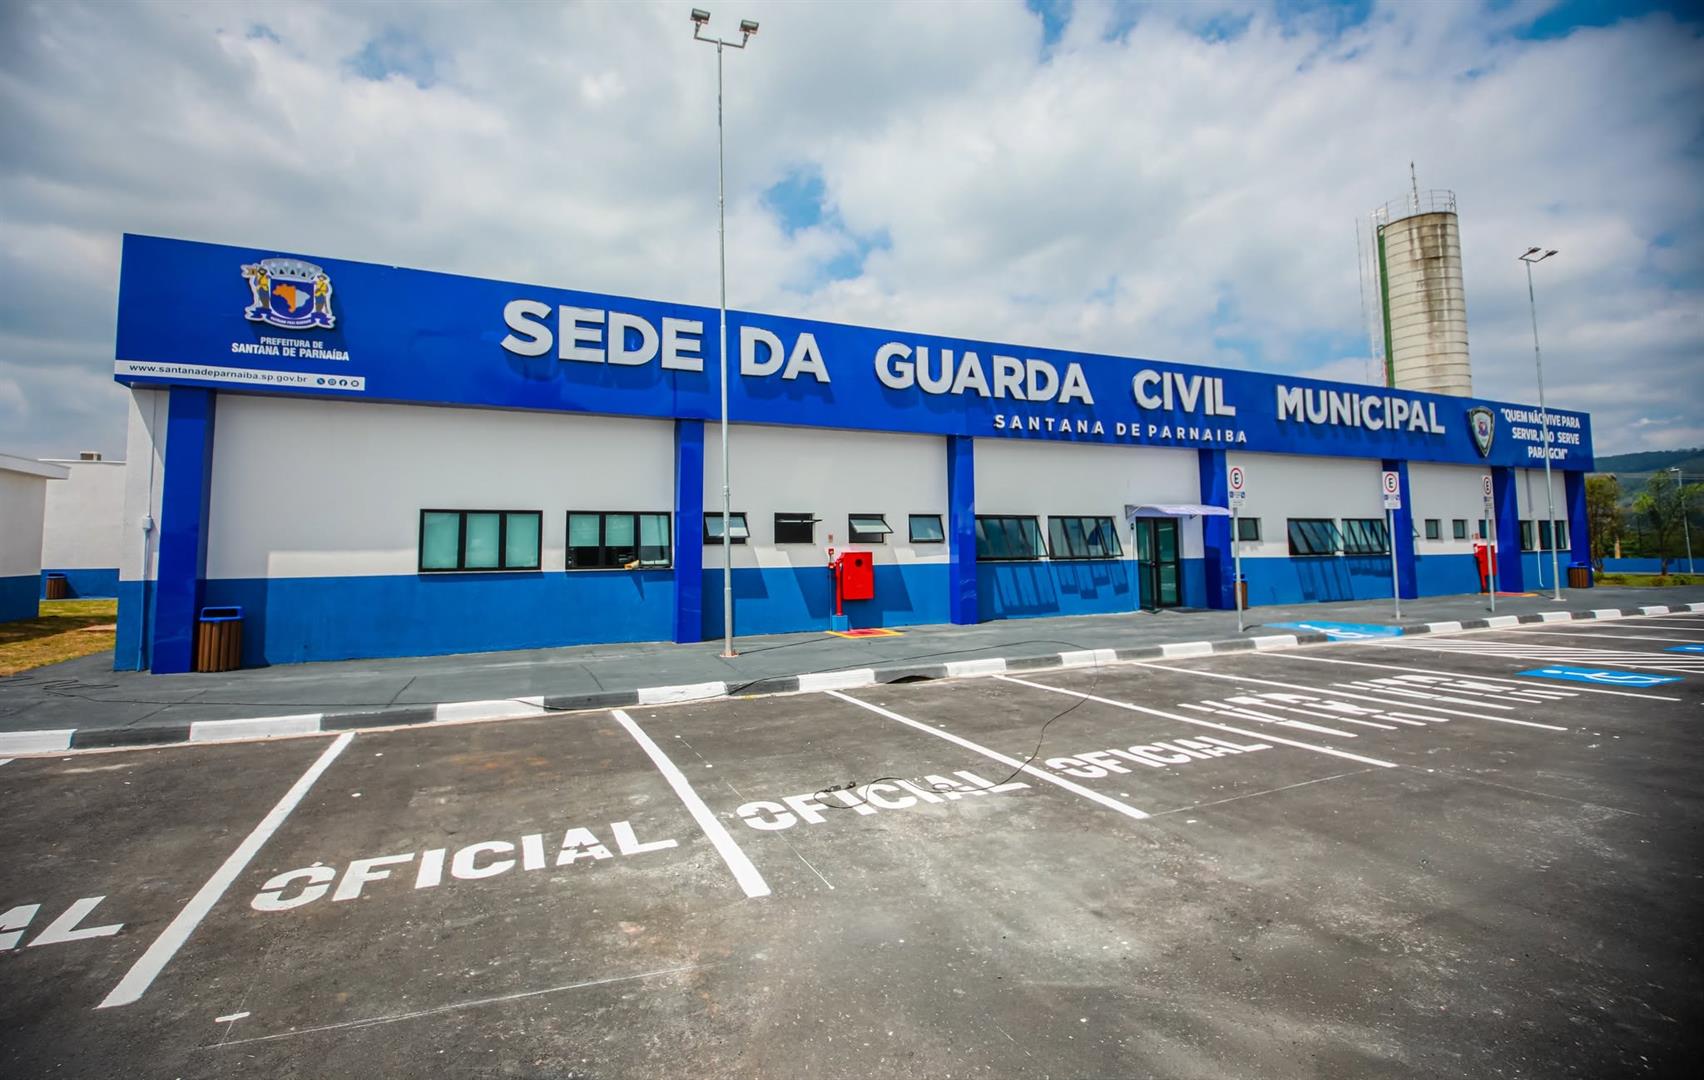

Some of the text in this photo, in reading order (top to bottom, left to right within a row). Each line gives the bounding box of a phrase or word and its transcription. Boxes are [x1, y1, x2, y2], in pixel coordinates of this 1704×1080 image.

[231, 342, 350, 361] SANTANA DE PARNAÍBA
[260, 336, 323, 349] PREFEITURA DE
[500, 299, 1445, 434] SEDE DA GUARDA CIVIL MUNICIPAL
[993, 415, 1247, 443] SANTANA DE PARNAIBA
[1562, 416, 1580, 428] PARA
[1540, 429, 1555, 443] NO
[1557, 432, 1580, 444] SERVE
[1045, 736, 1273, 779] OFICIAL
[735, 770, 1032, 832] OFICIAL
[250, 820, 679, 912] OFICIAL
